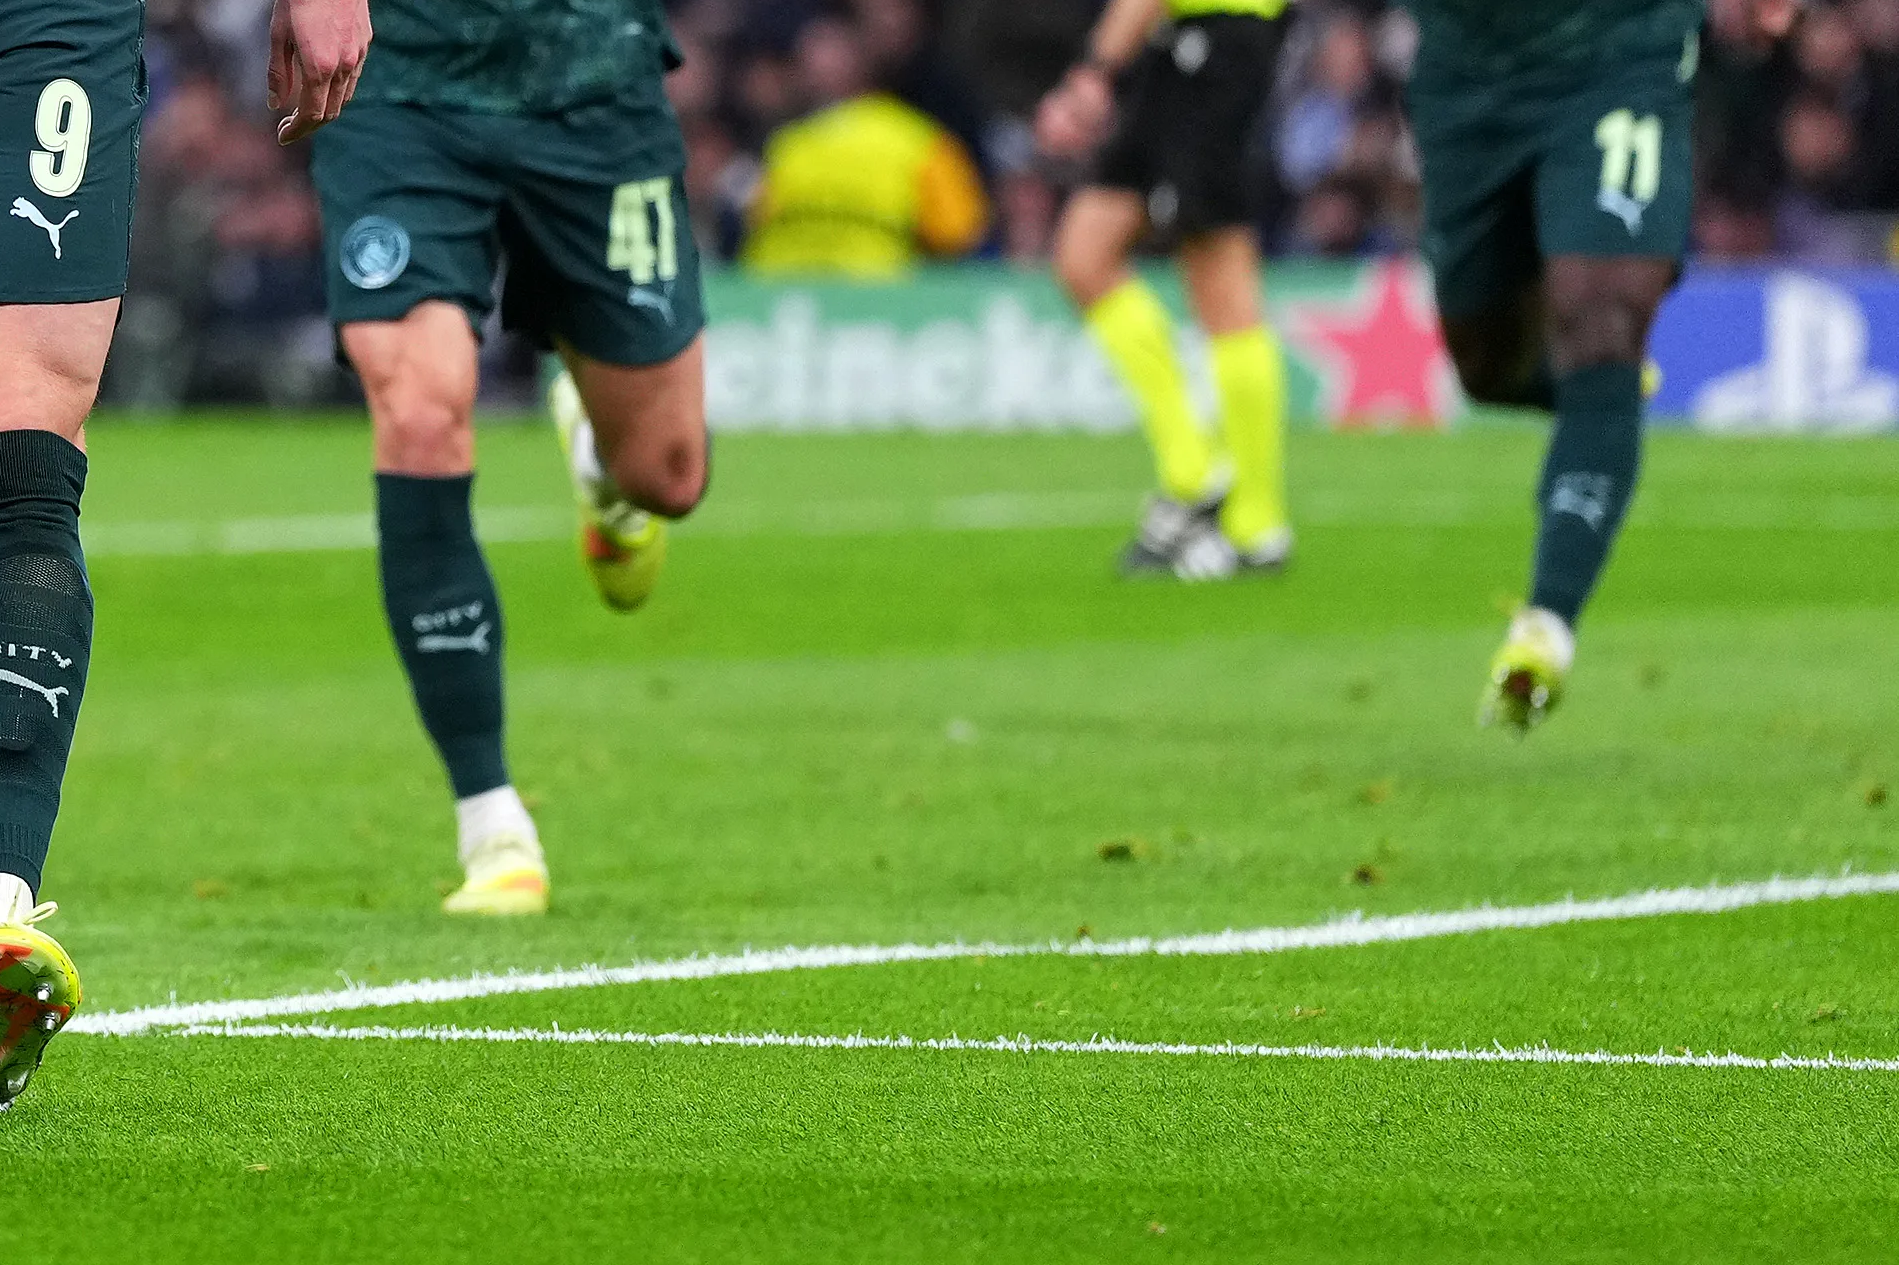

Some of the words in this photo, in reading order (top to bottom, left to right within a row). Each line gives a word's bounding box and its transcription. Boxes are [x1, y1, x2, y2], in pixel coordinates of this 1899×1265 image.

[30, 78, 92, 197] 9
[1593, 107, 1663, 202] 11
[605, 176, 678, 285] 41
